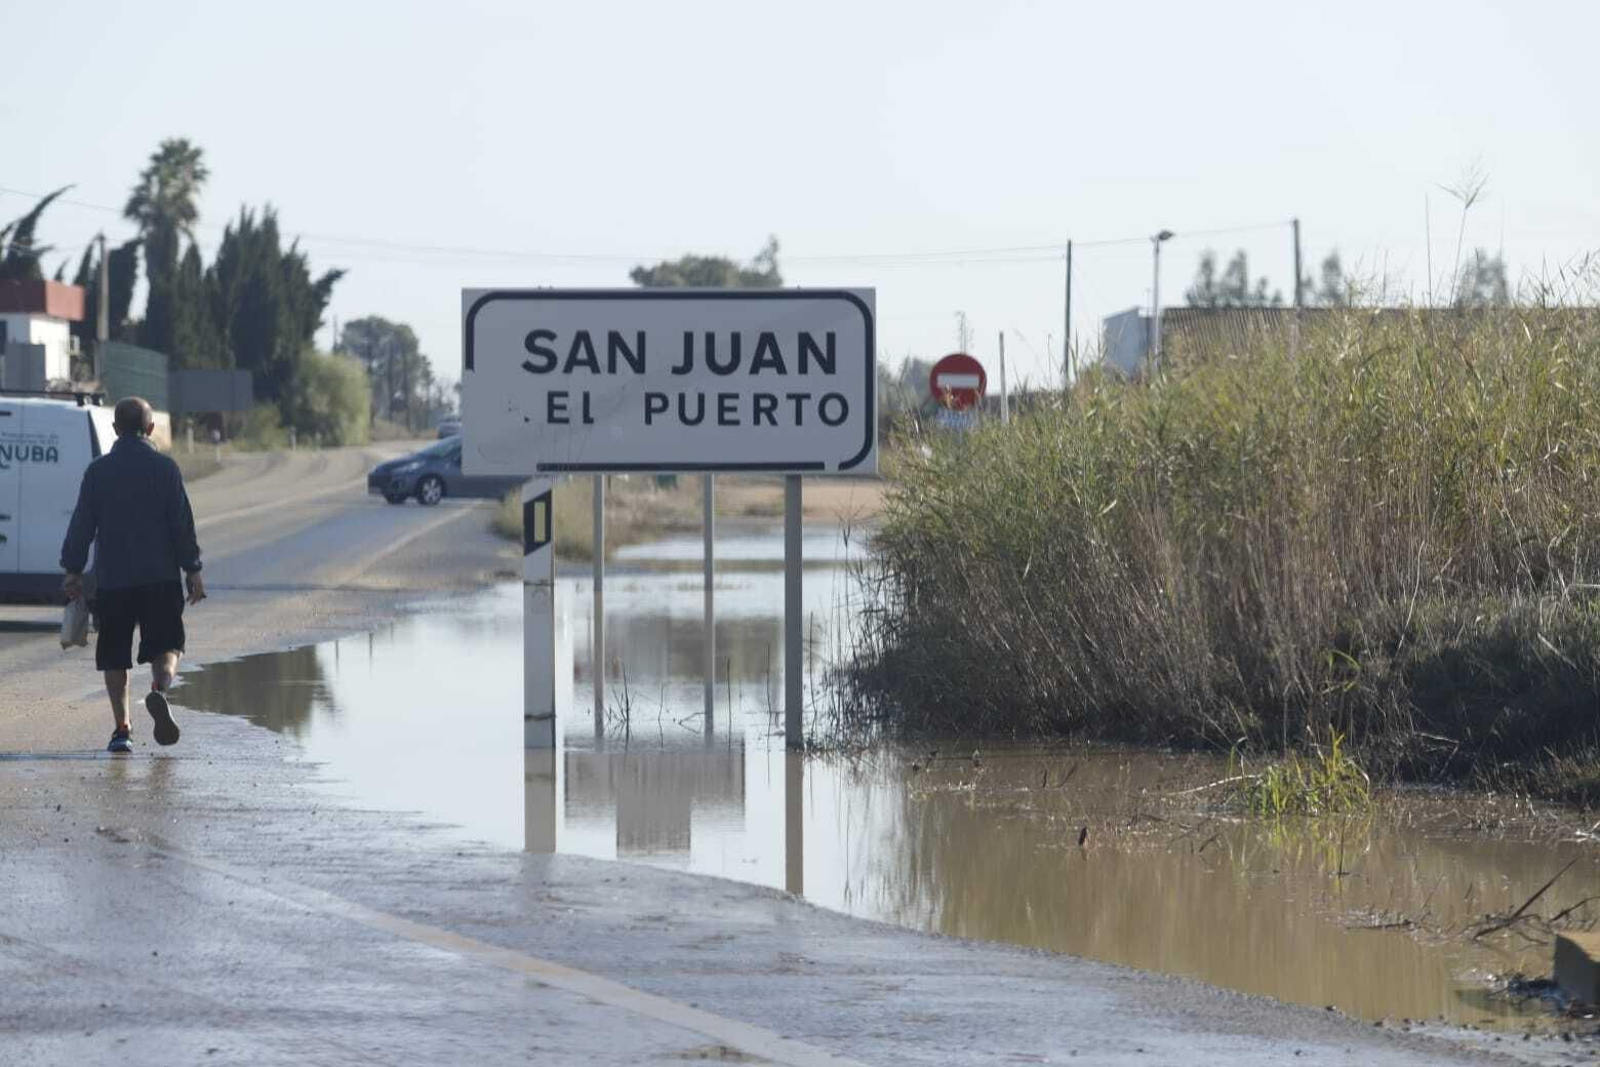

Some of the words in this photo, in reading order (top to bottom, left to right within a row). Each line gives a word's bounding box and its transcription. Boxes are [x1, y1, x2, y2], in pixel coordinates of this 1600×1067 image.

[521, 329, 646, 375] SAN
[670, 331, 837, 376] JUAN
[644, 391, 850, 427] PUERTO
